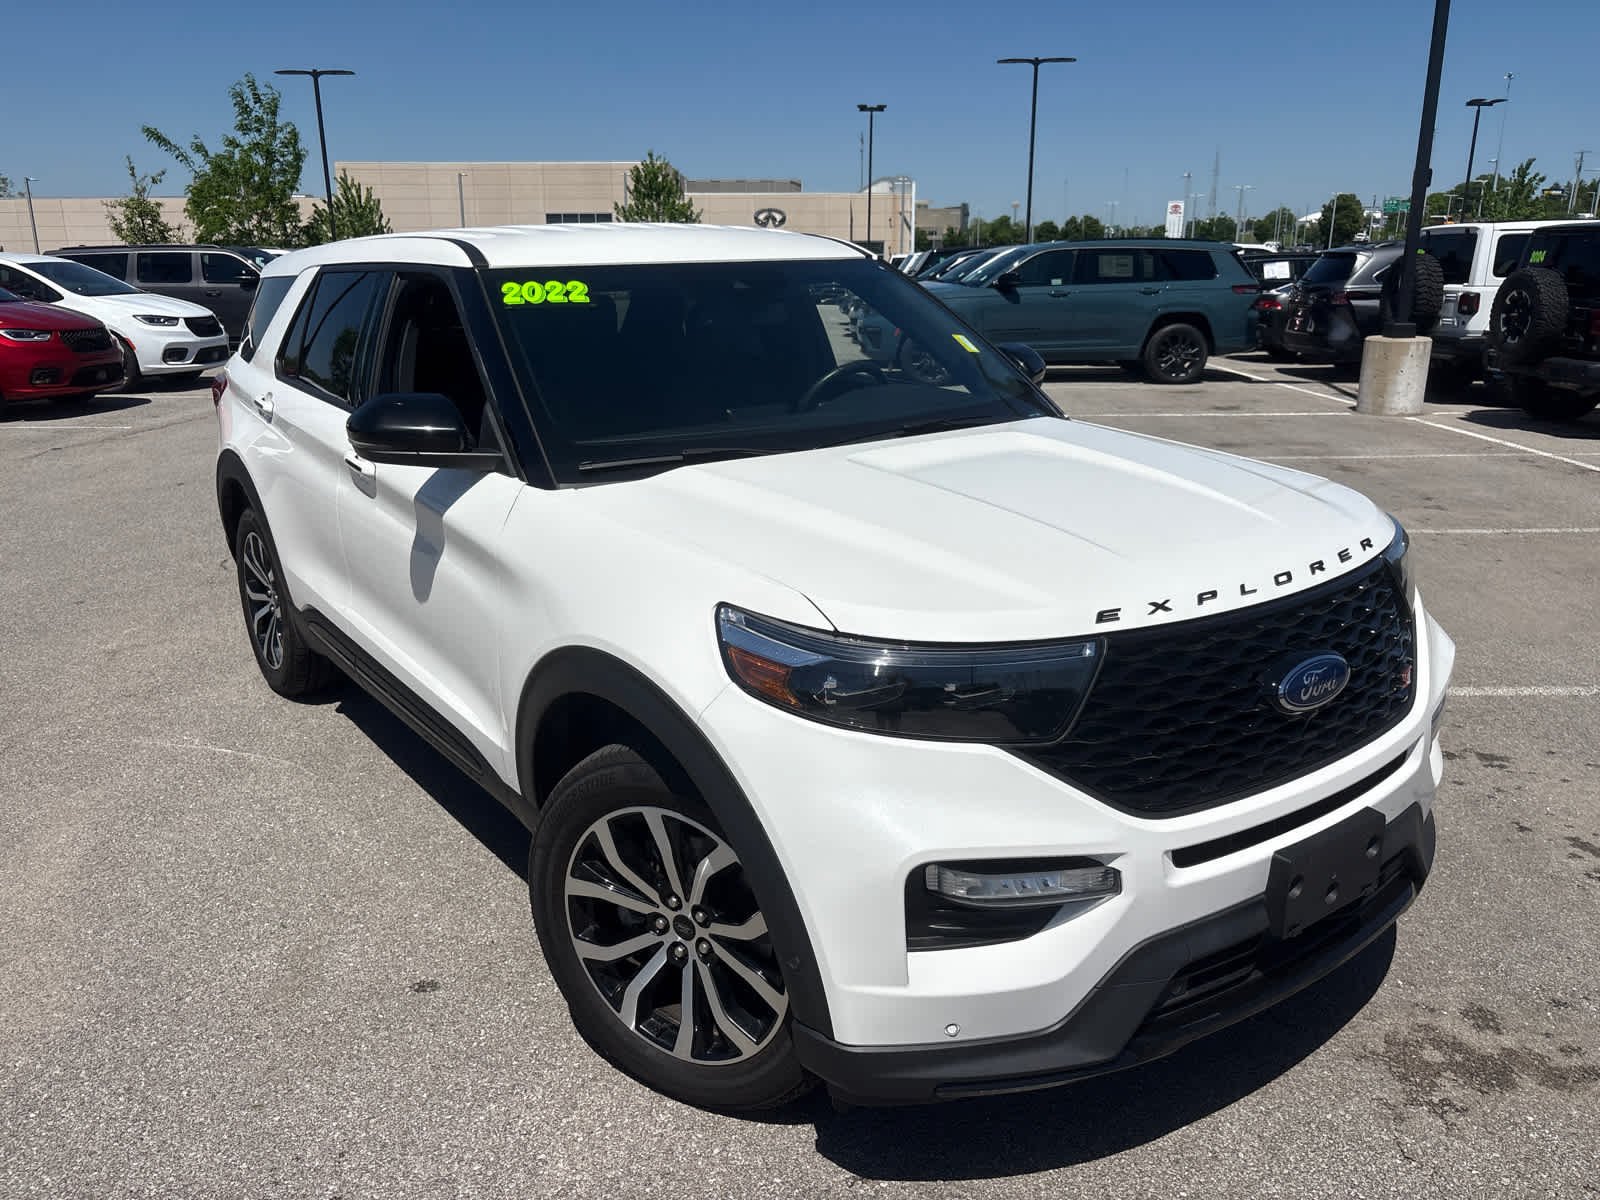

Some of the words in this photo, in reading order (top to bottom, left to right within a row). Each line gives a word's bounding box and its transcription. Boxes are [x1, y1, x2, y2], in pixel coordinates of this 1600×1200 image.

[501, 280, 590, 304] 2022
[1095, 537, 1374, 624] EXPLORER
[1299, 665, 1338, 700] Ford
